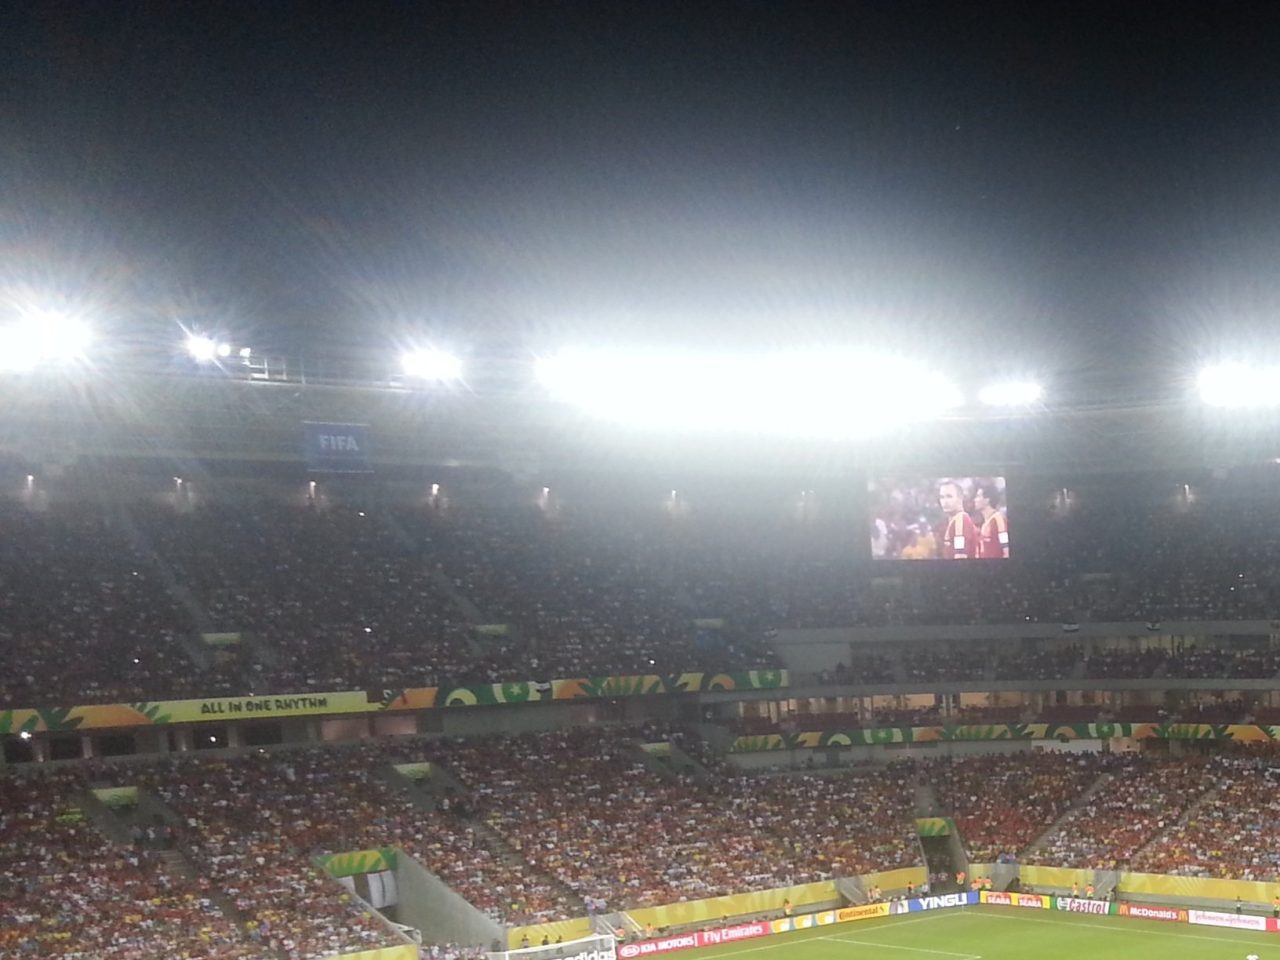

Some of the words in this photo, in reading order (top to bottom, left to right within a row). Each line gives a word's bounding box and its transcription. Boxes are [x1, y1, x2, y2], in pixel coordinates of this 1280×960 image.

[319, 434, 359, 451] FIFA
[201, 702, 225, 714] ALL
[229, 701, 242, 712] IN
[245, 700, 272, 711] ONE
[274, 697, 328, 710] RHYTHM
[919, 892, 968, 911] YINGLI
[1069, 900, 1108, 915] Castrol
[1130, 906, 1178, 920] McDonald's
[703, 930, 721, 944] Fly
[722, 925, 763, 939] Emirates
